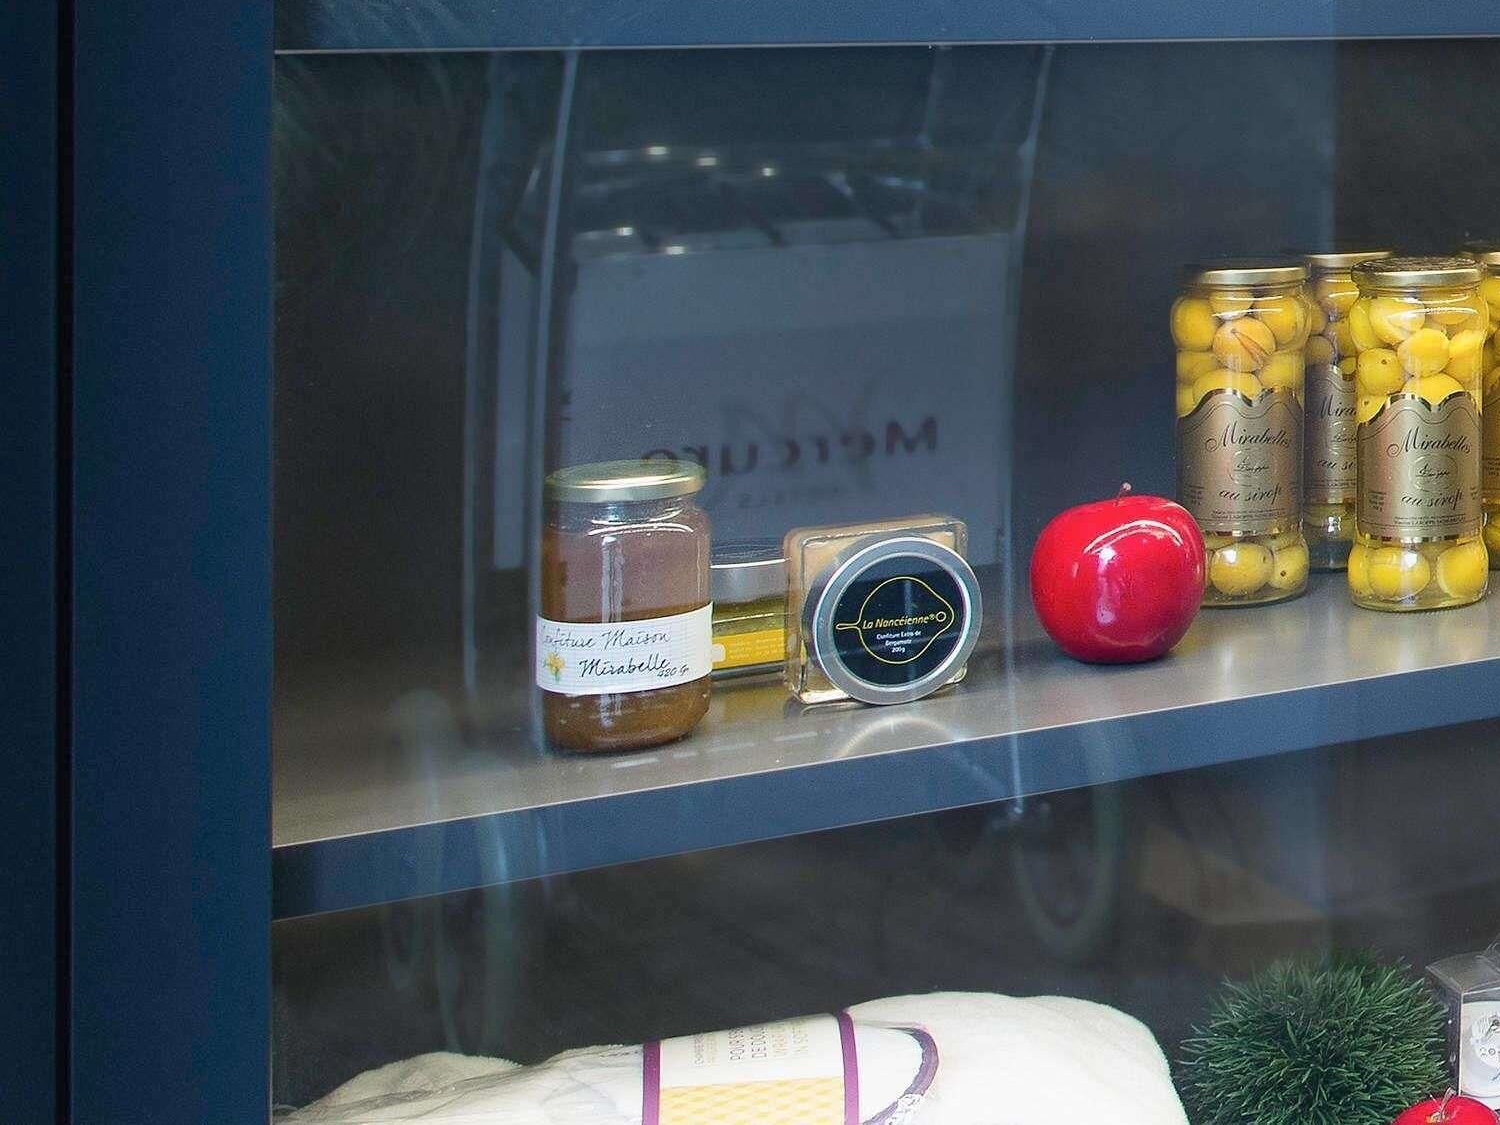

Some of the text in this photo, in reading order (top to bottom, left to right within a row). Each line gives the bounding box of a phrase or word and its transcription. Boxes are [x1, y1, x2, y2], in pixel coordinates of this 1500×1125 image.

[1386, 426, 1472, 458] Mirabelles
[1245, 482, 1281, 505] sirop
[1401, 494, 1424, 506] au
[1426, 486, 1463, 510] sirop
[579, 652, 671, 678] Mirabelle
